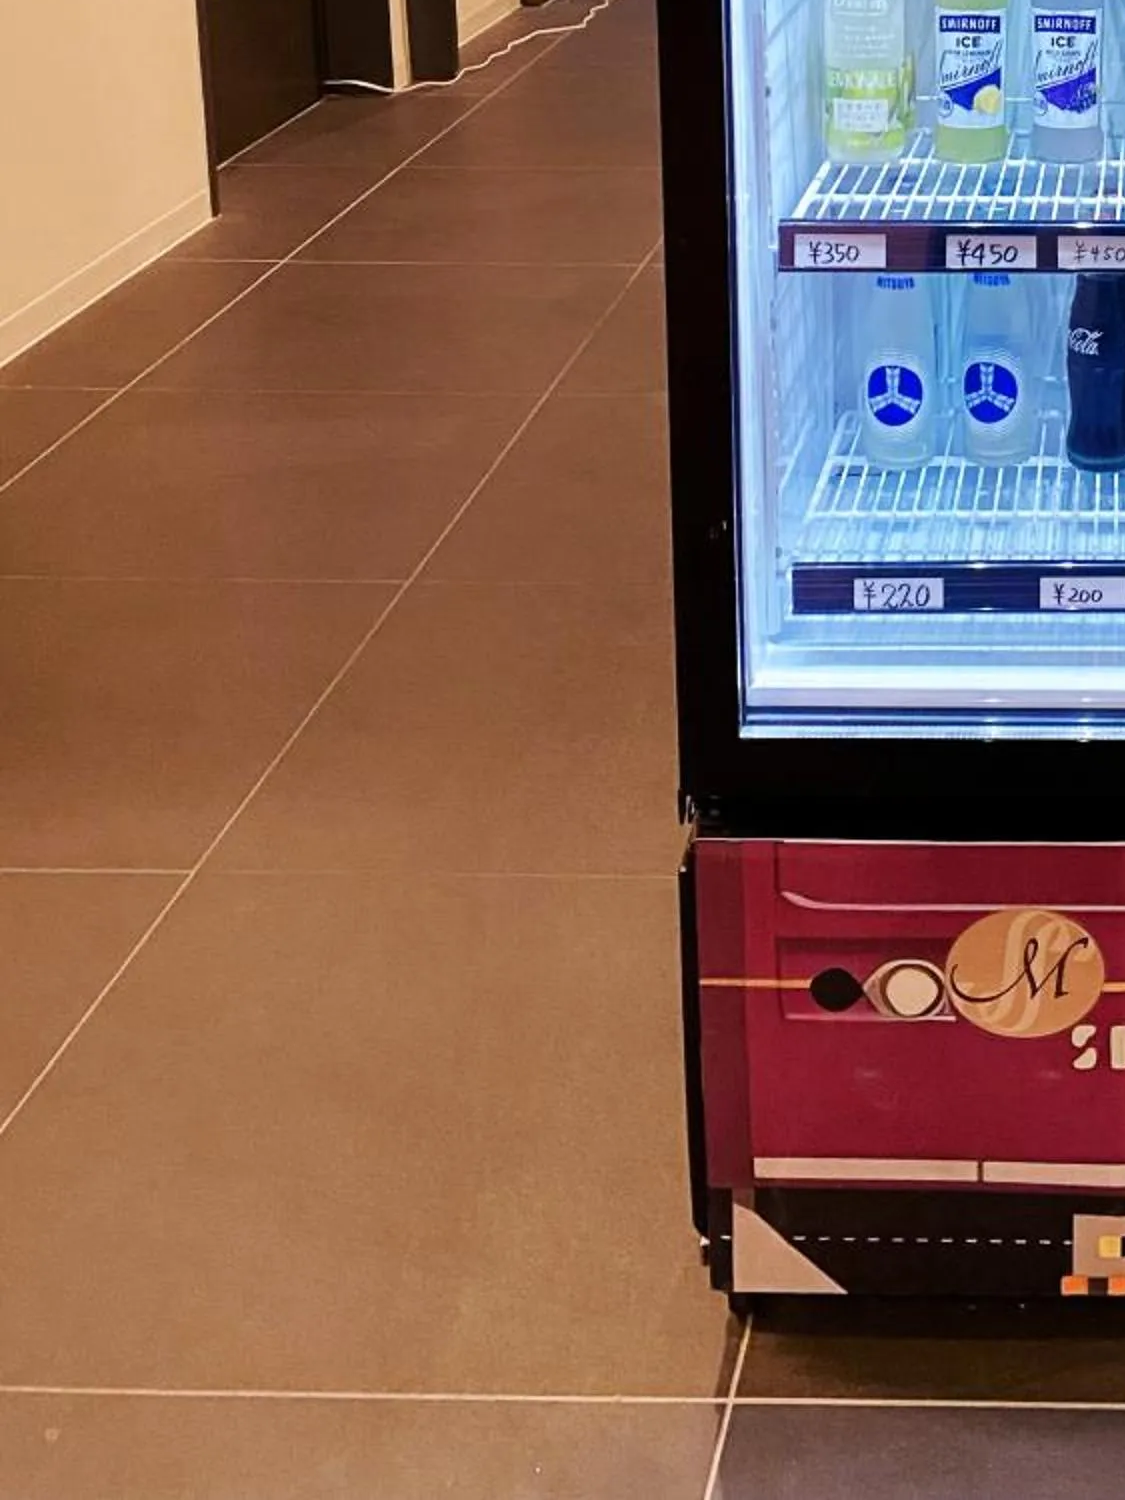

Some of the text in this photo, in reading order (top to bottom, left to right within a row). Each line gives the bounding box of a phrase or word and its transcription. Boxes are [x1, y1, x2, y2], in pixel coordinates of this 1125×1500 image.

[941, 17, 999, 30] SMIRNOFF
[1037, 17, 1093, 31] SMIRNOFF
[956, 36, 981, 48] ICE
[1051, 36, 1075, 48] ICE
[809, 241, 860, 264] ¥350
[956, 239, 1018, 266] ¥450
[863, 580, 931, 608] ¥220
[1053, 583, 1103, 604] ¥200
